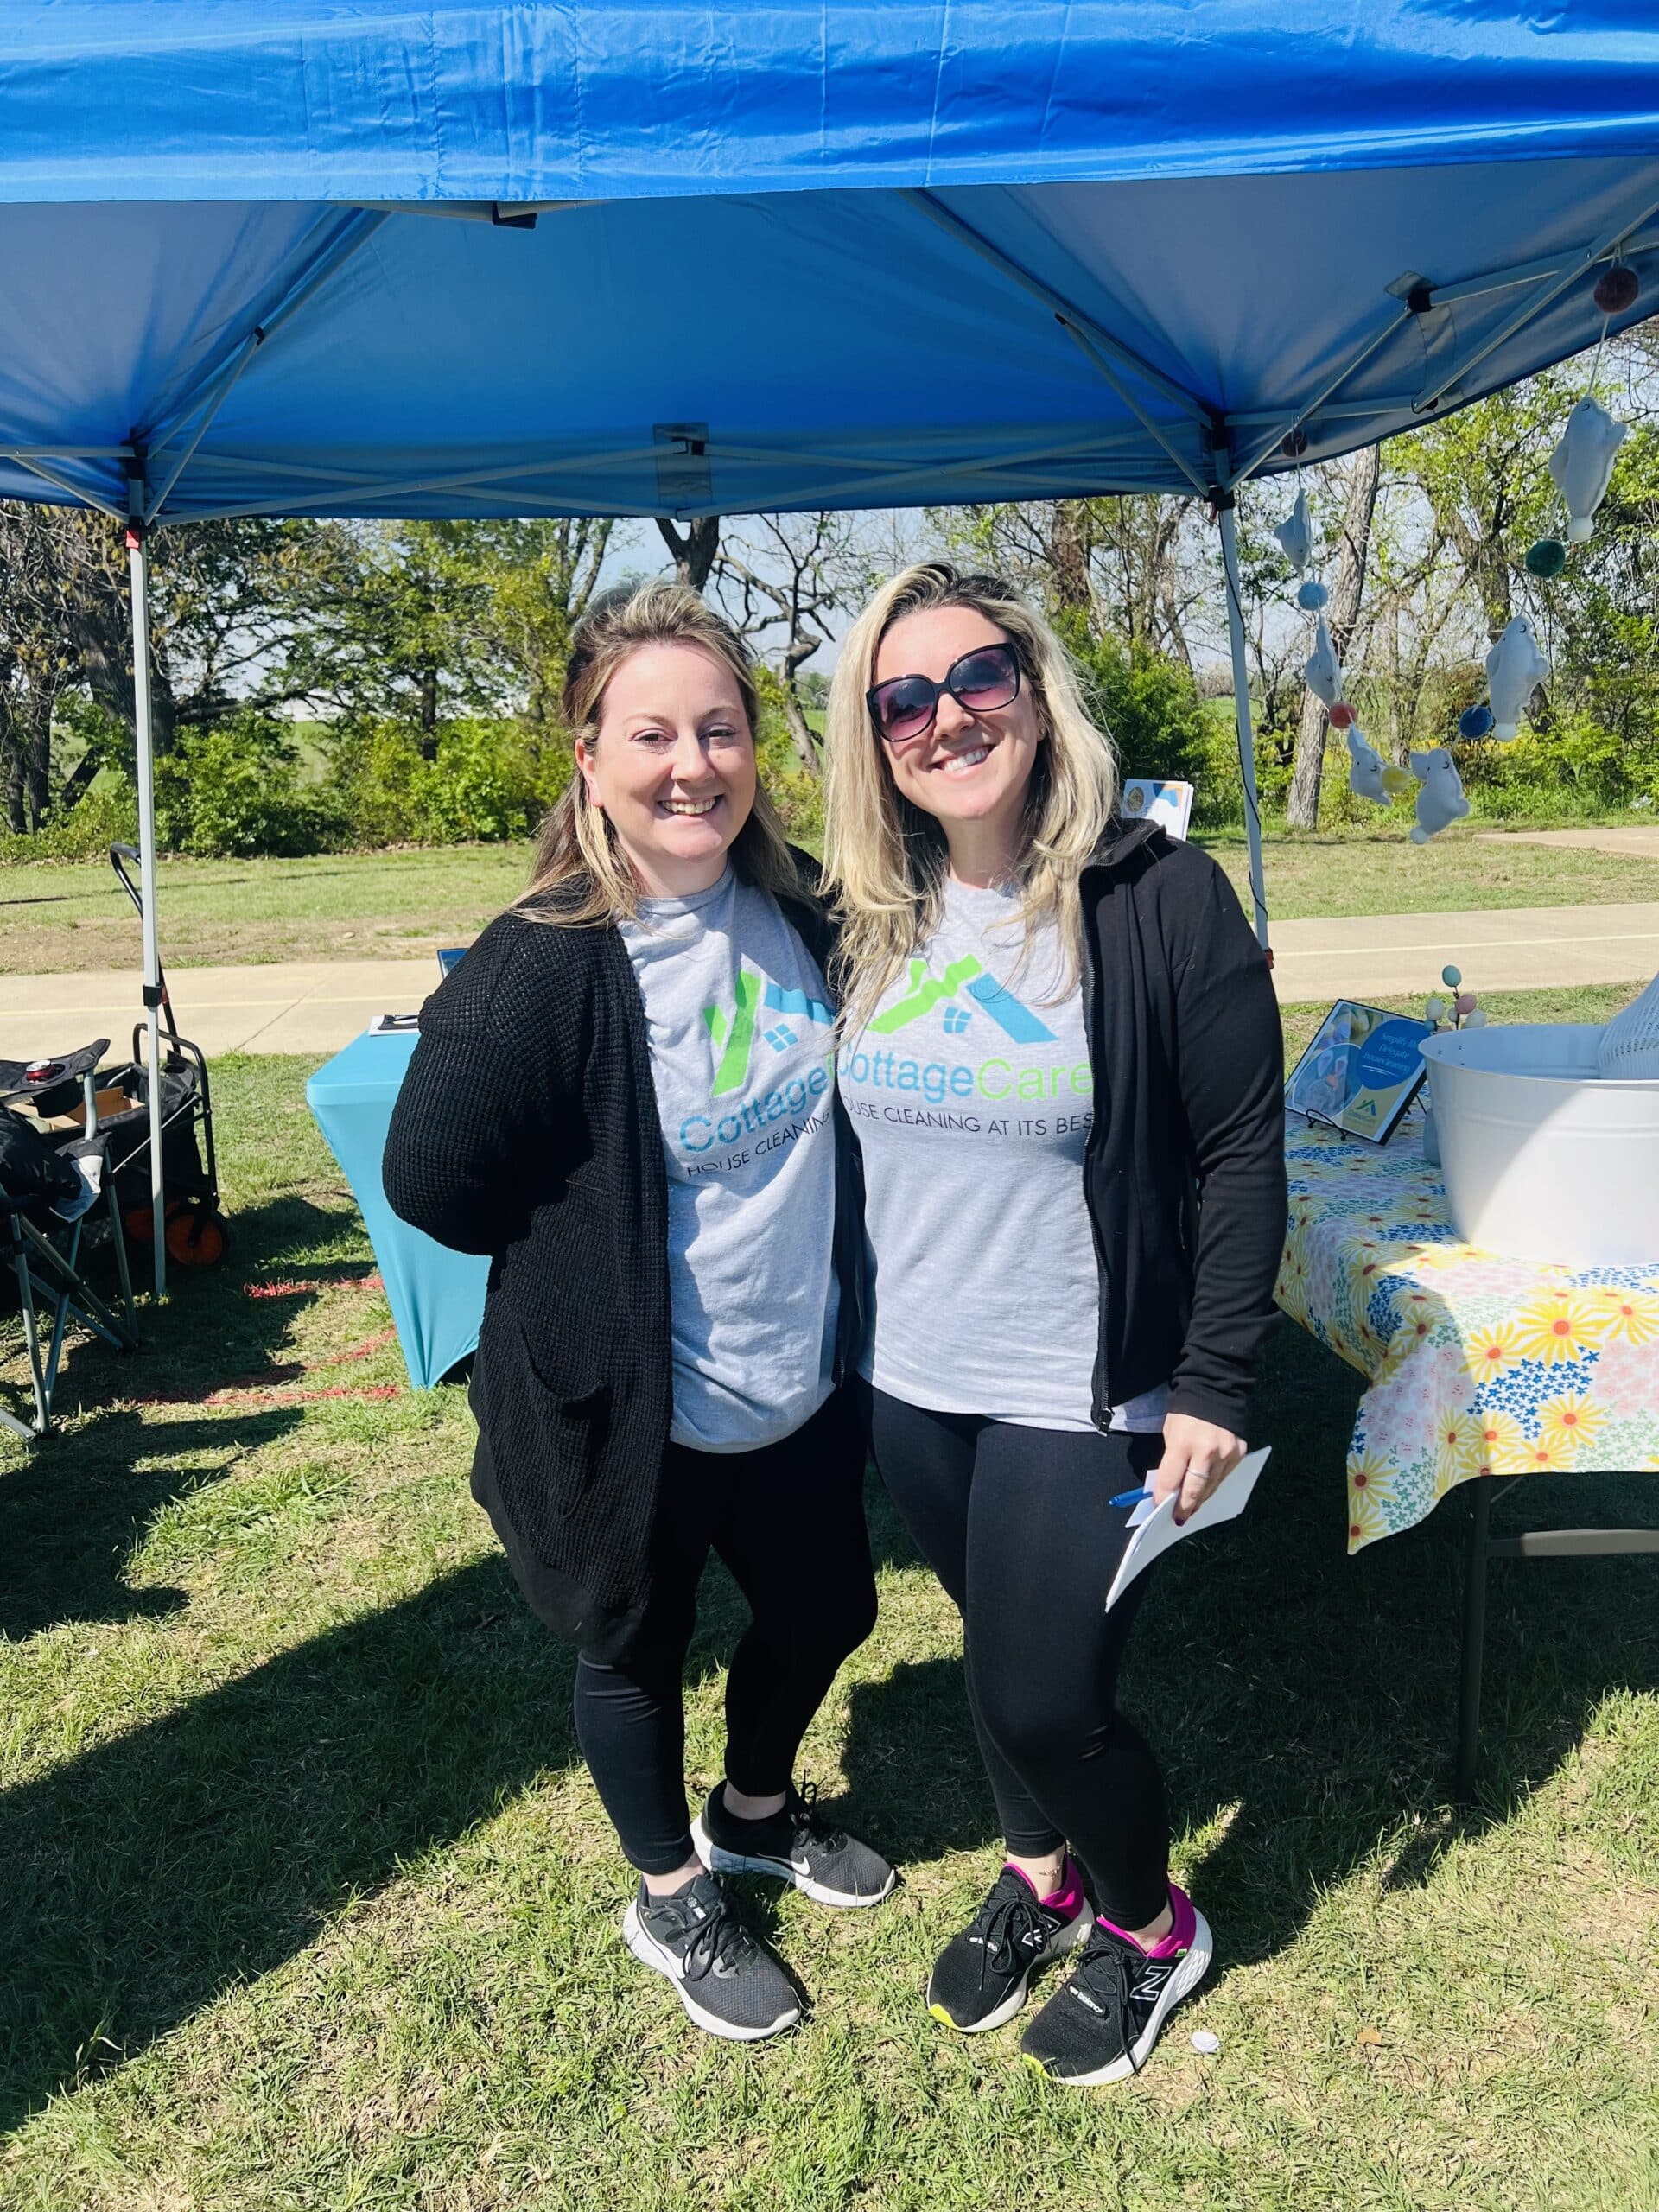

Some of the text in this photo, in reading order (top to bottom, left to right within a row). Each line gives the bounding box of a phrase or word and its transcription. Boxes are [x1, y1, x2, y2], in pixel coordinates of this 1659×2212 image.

[883, 1107, 981, 1133] CLEANING
[988, 1119, 1010, 1136] AT
[1017, 1119, 1047, 1136] ITS
[1055, 1112, 1094, 1135] BES
